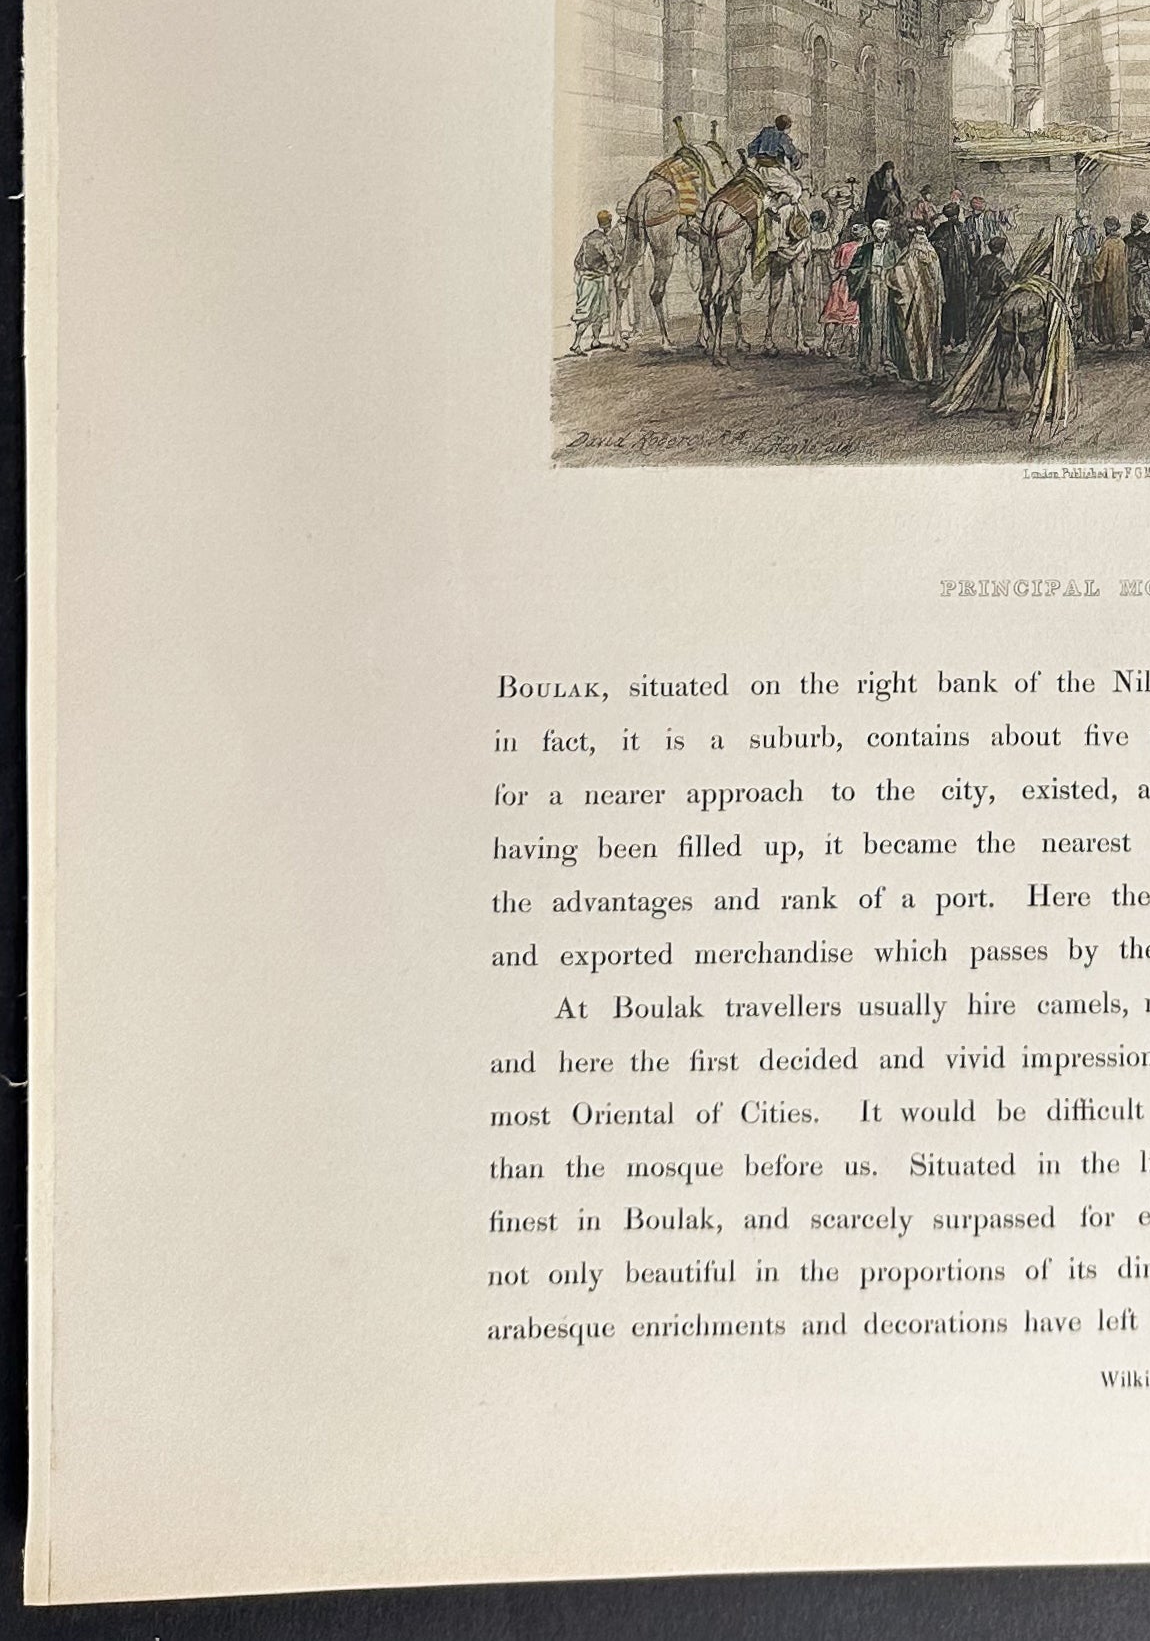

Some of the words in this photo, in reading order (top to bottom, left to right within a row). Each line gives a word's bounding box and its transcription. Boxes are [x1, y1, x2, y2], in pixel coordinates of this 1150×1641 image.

[938, 577, 1102, 598] PRINCIPAL
[629, 673, 729, 701] situated
[751, 680, 780, 696] on
[800, 671, 839, 695] the
[857, 670, 918, 703] right
[937, 670, 999, 694] bank
[1015, 670, 1042, 694] of
[1056, 670, 1095, 693] the
[494, 729, 518, 753] in
[542, 728, 595, 757] fact,
[622, 728, 640, 752] it
[666, 727, 685, 751] is
[711, 734, 724, 750] a
[749, 724, 842, 753] suburb,
[867, 723, 969, 748] contains
[992, 723, 1061, 748] about
[1084, 723, 1128, 748] five
[492, 836, 578, 869] having
[597, 835, 658, 862] been
[677, 833, 742, 859] filled
[763, 841, 804, 867] up,
[825, 832, 843, 856] it
[863, 831, 957, 856] became
[976, 830, 1015, 854] the
[1042, 833, 1132, 855] nearest
[492, 943, 539, 968] and
[560, 942, 674, 978] exported
[694, 940, 853, 967] merchandise
[874, 938, 947, 965] which
[970, 945, 1048, 972] passes
[1067, 937, 1099, 971] by
[553, 996, 589, 1021] At
[612, 995, 705, 1021] Boulak
[725, 993, 841, 1021] travellers
[858, 992, 948, 1024] usually
[968, 992, 1016, 1017] hire
[1037, 990, 1128, 1021] camels,
[490, 1106, 551, 1128] most
[572, 1101, 674, 1128] Oriental
[696, 1101, 724, 1125] of
[741, 1100, 819, 1125] Cities.
[860, 1099, 882, 1123] It
[900, 1099, 976, 1125] would
[996, 1098, 1026, 1124] be
[1047, 1097, 1144, 1124] difficult
[489, 1209, 558, 1234] finest
[577, 1208, 601, 1232] in
[623, 1206, 722, 1236] Boulak,
[744, 1206, 790, 1232] and
[810, 1206, 914, 1240] scarcely
[933, 1205, 1056, 1238] surpassed
[1080, 1204, 1115, 1229] for
[488, 1315, 615, 1349] arabesque
[632, 1313, 785, 1339] enrichments
[802, 1312, 847, 1338] and
[864, 1310, 1007, 1336] decorations
[1024, 1309, 1081, 1334] have
[1098, 1307, 1139, 1332] left
